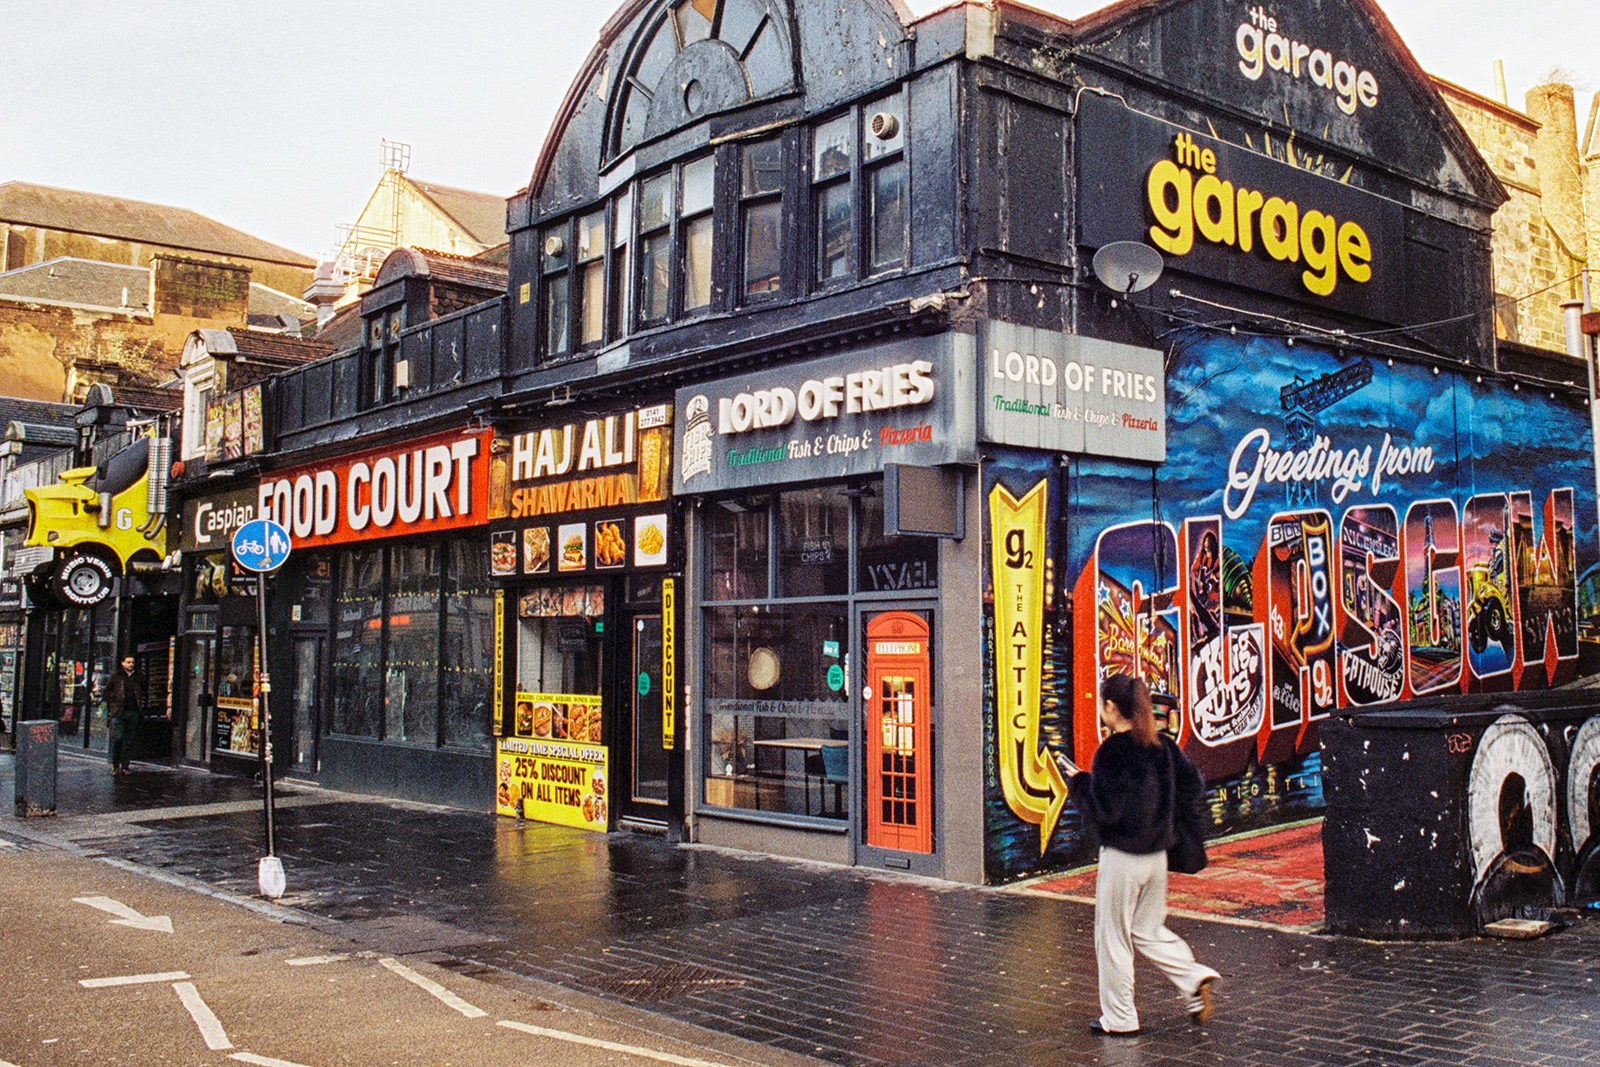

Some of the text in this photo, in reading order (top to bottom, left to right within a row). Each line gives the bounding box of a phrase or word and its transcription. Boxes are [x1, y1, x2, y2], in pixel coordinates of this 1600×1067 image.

[1249, 5, 1278, 33] the
[1235, 22, 1379, 115] garage
[1174, 131, 1217, 174] the
[1147, 159, 1372, 297] garage
[718, 359, 935, 435] LORD OF FRIES
[993, 348, 1157, 403] LORD OF FRIES
[992, 394, 1158, 432] Traditional Fish & Chips & Pizzeria
[512, 411, 636, 481] HAJ ALI
[726, 421, 933, 467] Traditional Fish & Chips & Pizzeria
[258, 437, 478, 538] FOOD COURT
[511, 473, 632, 519] SHAWARMA
[1223, 427, 1436, 520] Greetings from
[116, 508, 133, 531] G
[194, 500, 254, 544] Caspian
[86, 556, 113, 579] VENUE
[1307, 536, 1330, 638] BOX
[1015, 583, 1024, 613] THE
[1092, 487, 1581, 750] GLASGOW
[665, 593, 673, 728] DISCOUNT
[877, 643, 919, 653] TELEPHONE
[1012, 621, 1028, 730] ATTIC
[1341, 650, 1399, 700] CATHOUSE
[500, 740, 605, 763] LIMITED TIME SPECIAL OFFER
[515, 757, 587, 786] 25% DISCOUNT
[521, 781, 581, 808] ON ALL ITEMS
